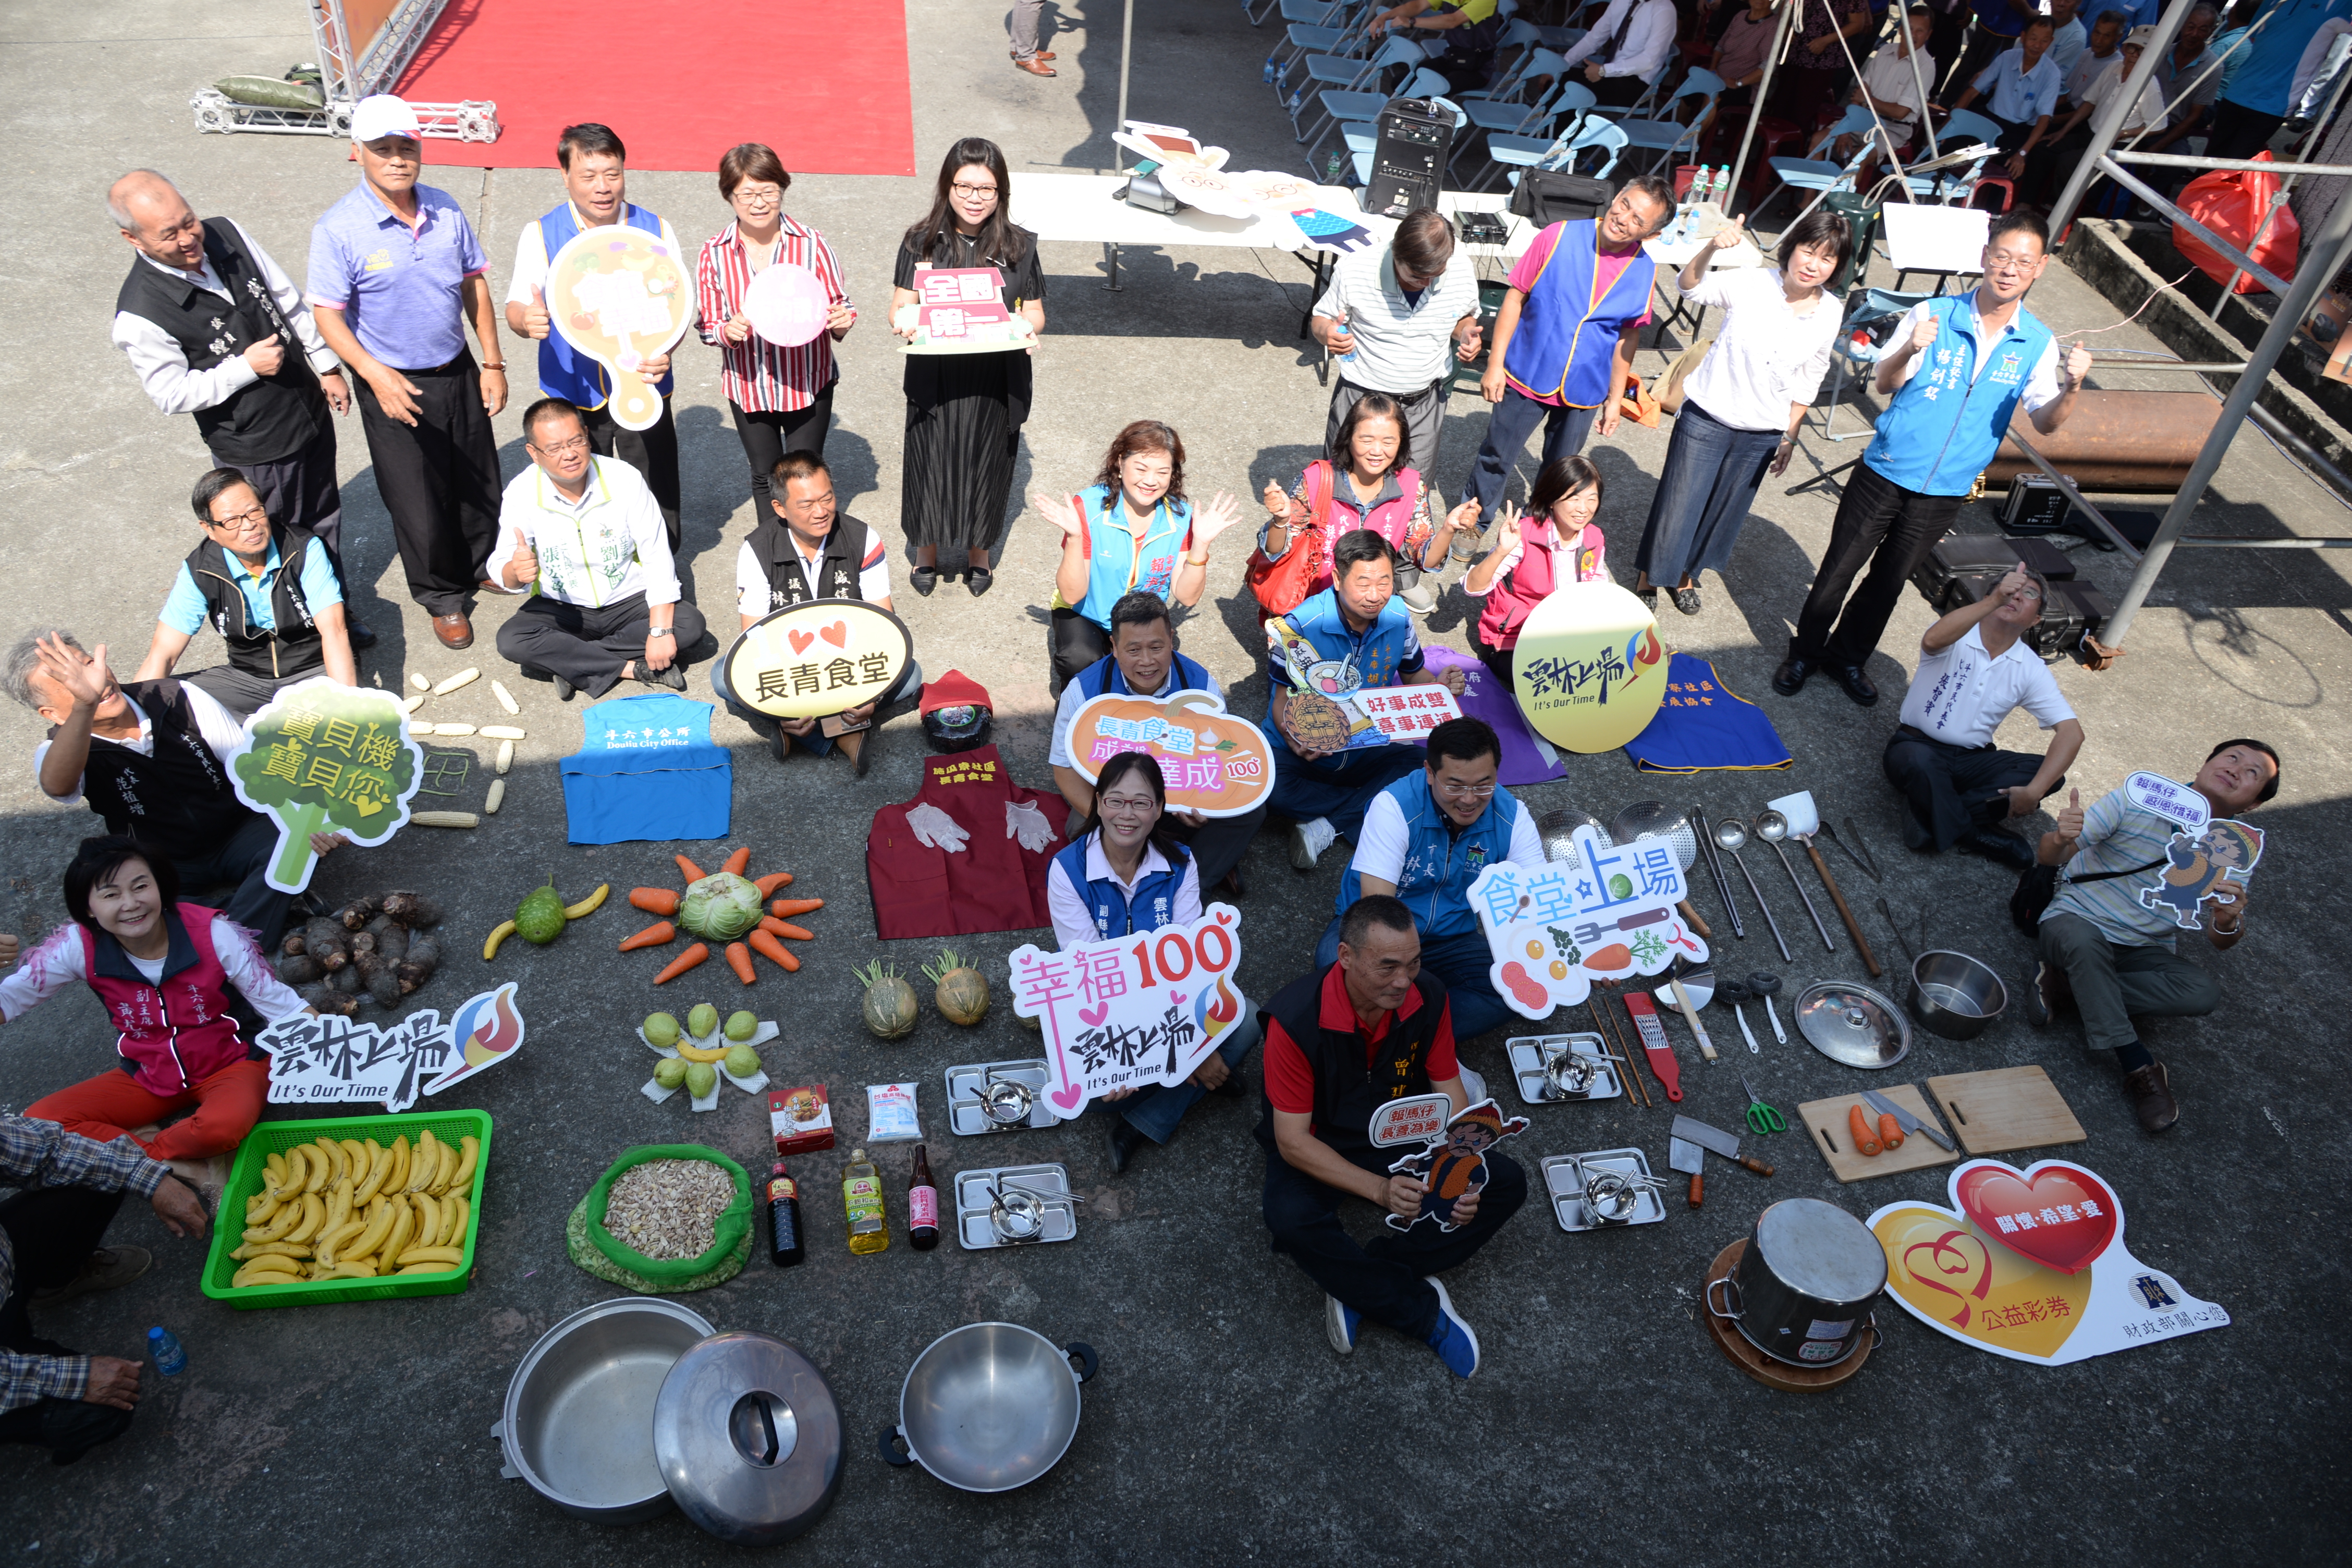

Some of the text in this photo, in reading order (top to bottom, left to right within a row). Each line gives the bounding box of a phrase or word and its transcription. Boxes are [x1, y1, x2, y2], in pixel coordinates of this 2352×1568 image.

[923, 273, 995, 303] 全國
[929, 308, 999, 337] 第一
[1947, 344, 1966, 390] 主任秘書
[755, 652, 890, 703] 長青食堂
[1521, 646, 1625, 708] 雲林上場
[1366, 691, 1448, 713] 好事成雙
[1534, 694, 1595, 710] It's Our Time
[1924, 672, 1951, 717] 張智賓
[1936, 663, 1971, 730] 斗六市民代表會
[277, 704, 399, 771] 寶貝機
[604, 726, 691, 741] 斗六市公所
[606, 738, 689, 750] Douliu City Office
[1098, 717, 1193, 753] 長青食堂
[124, 767, 140, 784] 代表
[1227, 757, 1260, 778] 100
[2135, 776, 2177, 798] 報馬仔
[2143, 795, 2201, 823] 感恩惜福
[1423, 843, 1438, 877] 市長
[1478, 838, 1679, 928] 食堂 上場
[1154, 897, 1170, 926] 雲林
[136, 988, 153, 1026] 副主席
[1069, 1006, 1195, 1077] 雲林上場
[262, 1014, 451, 1107] 雲林上場
[274, 1083, 388, 1098] It's Our Time
[1087, 1064, 1161, 1090] It's Our Time
[1390, 1102, 1436, 1123] 報馬仔
[1380, 1119, 1439, 1140] 長善為樂
[1982, 1295, 2071, 1331] 公益彩券
[2122, 1305, 2226, 1339] 財政部關心您
